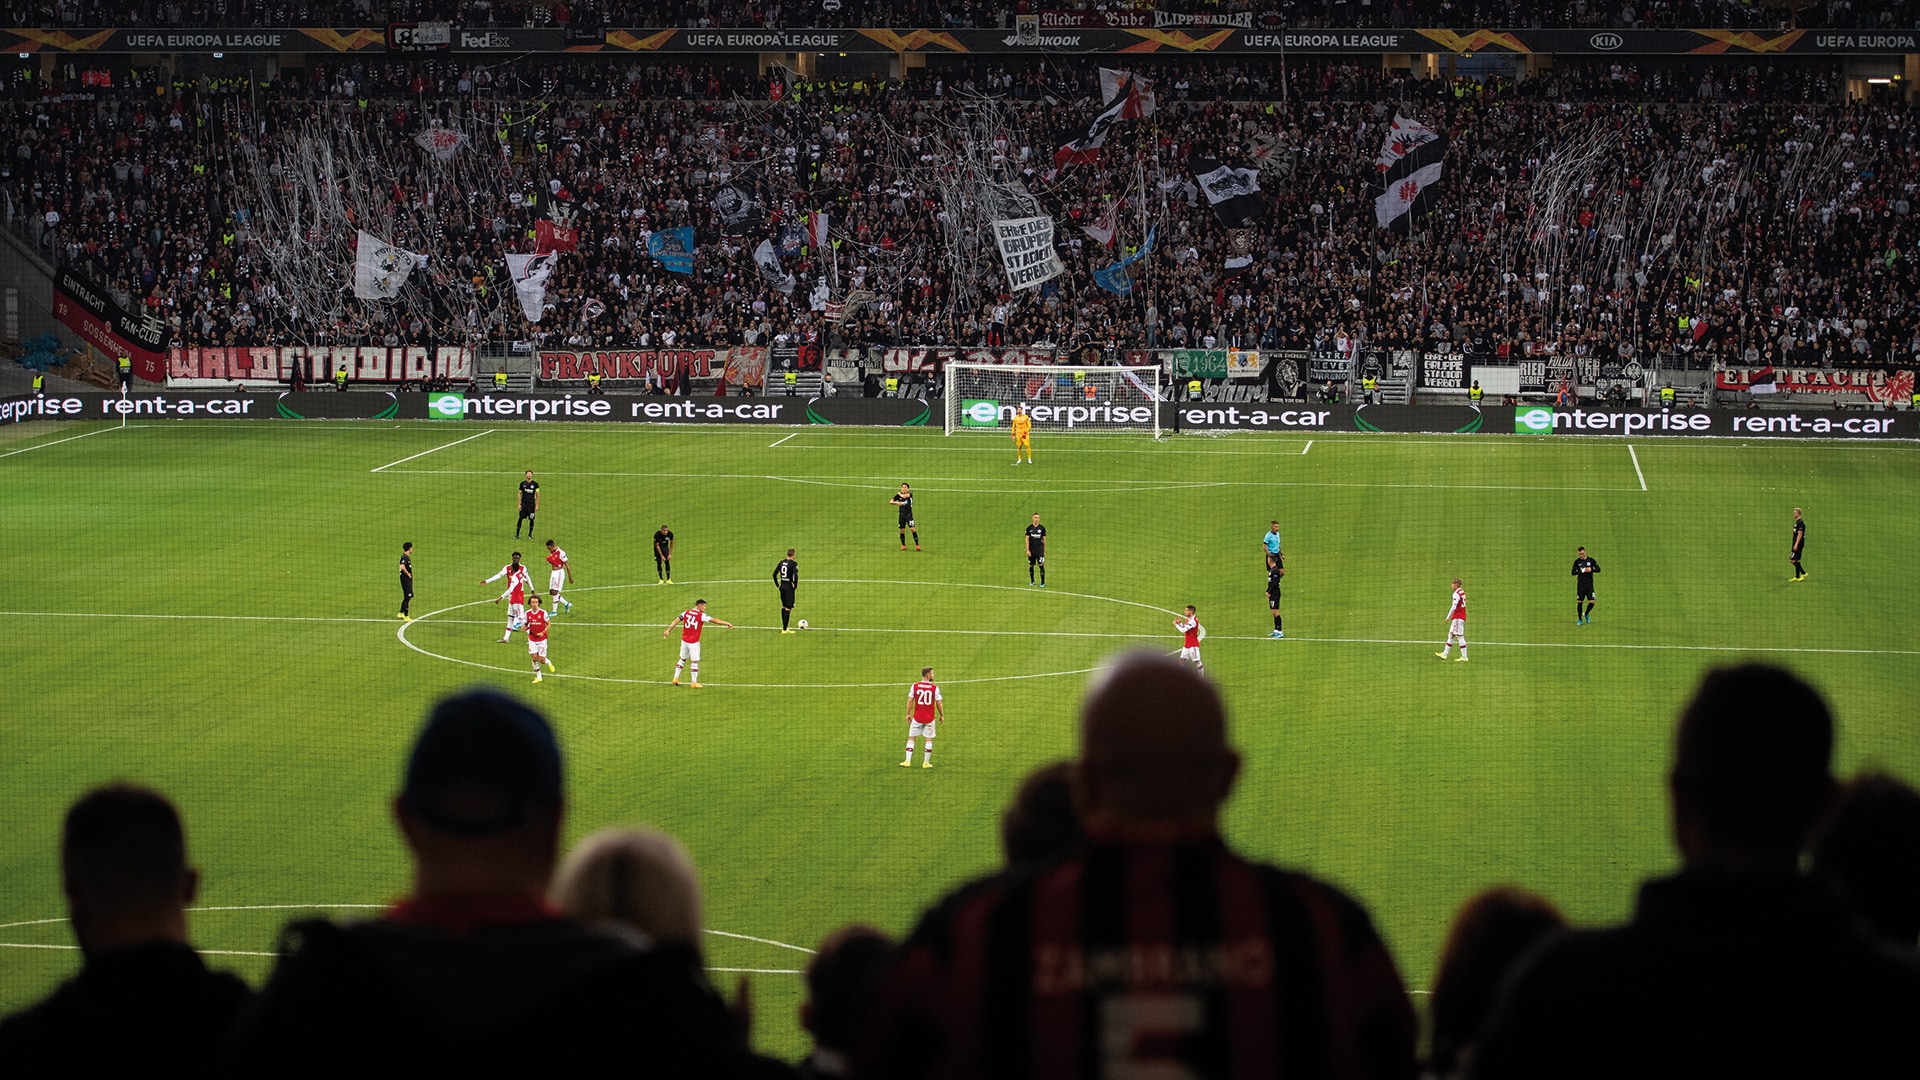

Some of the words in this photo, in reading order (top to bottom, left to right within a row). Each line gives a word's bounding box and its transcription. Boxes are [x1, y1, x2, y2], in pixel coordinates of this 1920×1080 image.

[1042, 12, 1084, 26] Nieder
[1105, 11, 1145, 27] Bube
[1153, 10, 1253, 28] KLIPPENADLER
[126, 35, 164, 46] UEFA
[168, 35, 222, 46] EUROPA
[226, 35, 281, 46] LEAGUE
[461, 32, 510, 48] FedEx
[687, 35, 724, 46] UEFA
[727, 35, 781, 46] EUROPA
[785, 35, 839, 46] LEAGUE
[1244, 35, 1281, 46] UEFA
[1285, 35, 1339, 46] EUROPA
[1343, 35, 1398, 46] LEAGUE
[1596, 37, 1617, 46] KIA
[1816, 35, 1855, 47] UEFA
[1859, 35, 1915, 48] EUROPA
[1000, 224, 1028, 238] EHRE
[1003, 230, 1052, 254] GRUPPE
[1006, 244, 1052, 269] STADION
[1010, 259, 1057, 287] VERBOT
[63, 274, 106, 313] EINTRACHT
[59, 303, 68, 316] 19
[83, 319, 131, 358] SOSSENHEIM
[120, 316, 161, 345] FAN-CLUB
[145, 360, 155, 372] 75
[171, 346, 471, 381] WALDSTADION
[539, 351, 715, 380] FRANKFURT
[831, 359, 855, 368] NUOVA
[1192, 351, 1227, 374] 1964
[1424, 360, 1463, 370] GRUPPE
[1519, 362, 1546, 376] RIED
[1547, 356, 1574, 367] FULDA
[1424, 370, 1463, 379] STADION
[1424, 378, 1463, 387] VERBOT
[1519, 376, 1546, 385] GEBIET
[1581, 375, 1596, 384] 64
[1723, 369, 1887, 387] EITRACHT
[1796, 386, 1812, 395] dir
[1817, 387, 1860, 397] ergeben
[103, 395, 254, 415] rent-a-car
[434, 394, 611, 421] enterprise
[631, 399, 784, 420] rent-a-car
[968, 401, 1152, 428] enterprise
[1179, 407, 1331, 426] rent-a-car
[1522, 408, 1711, 434] enterprise
[1733, 414, 1895, 434] rent-a-car
[781, 565, 788, 578] 9
[684, 613, 698, 630] 34
[916, 689, 933, 705] 20
